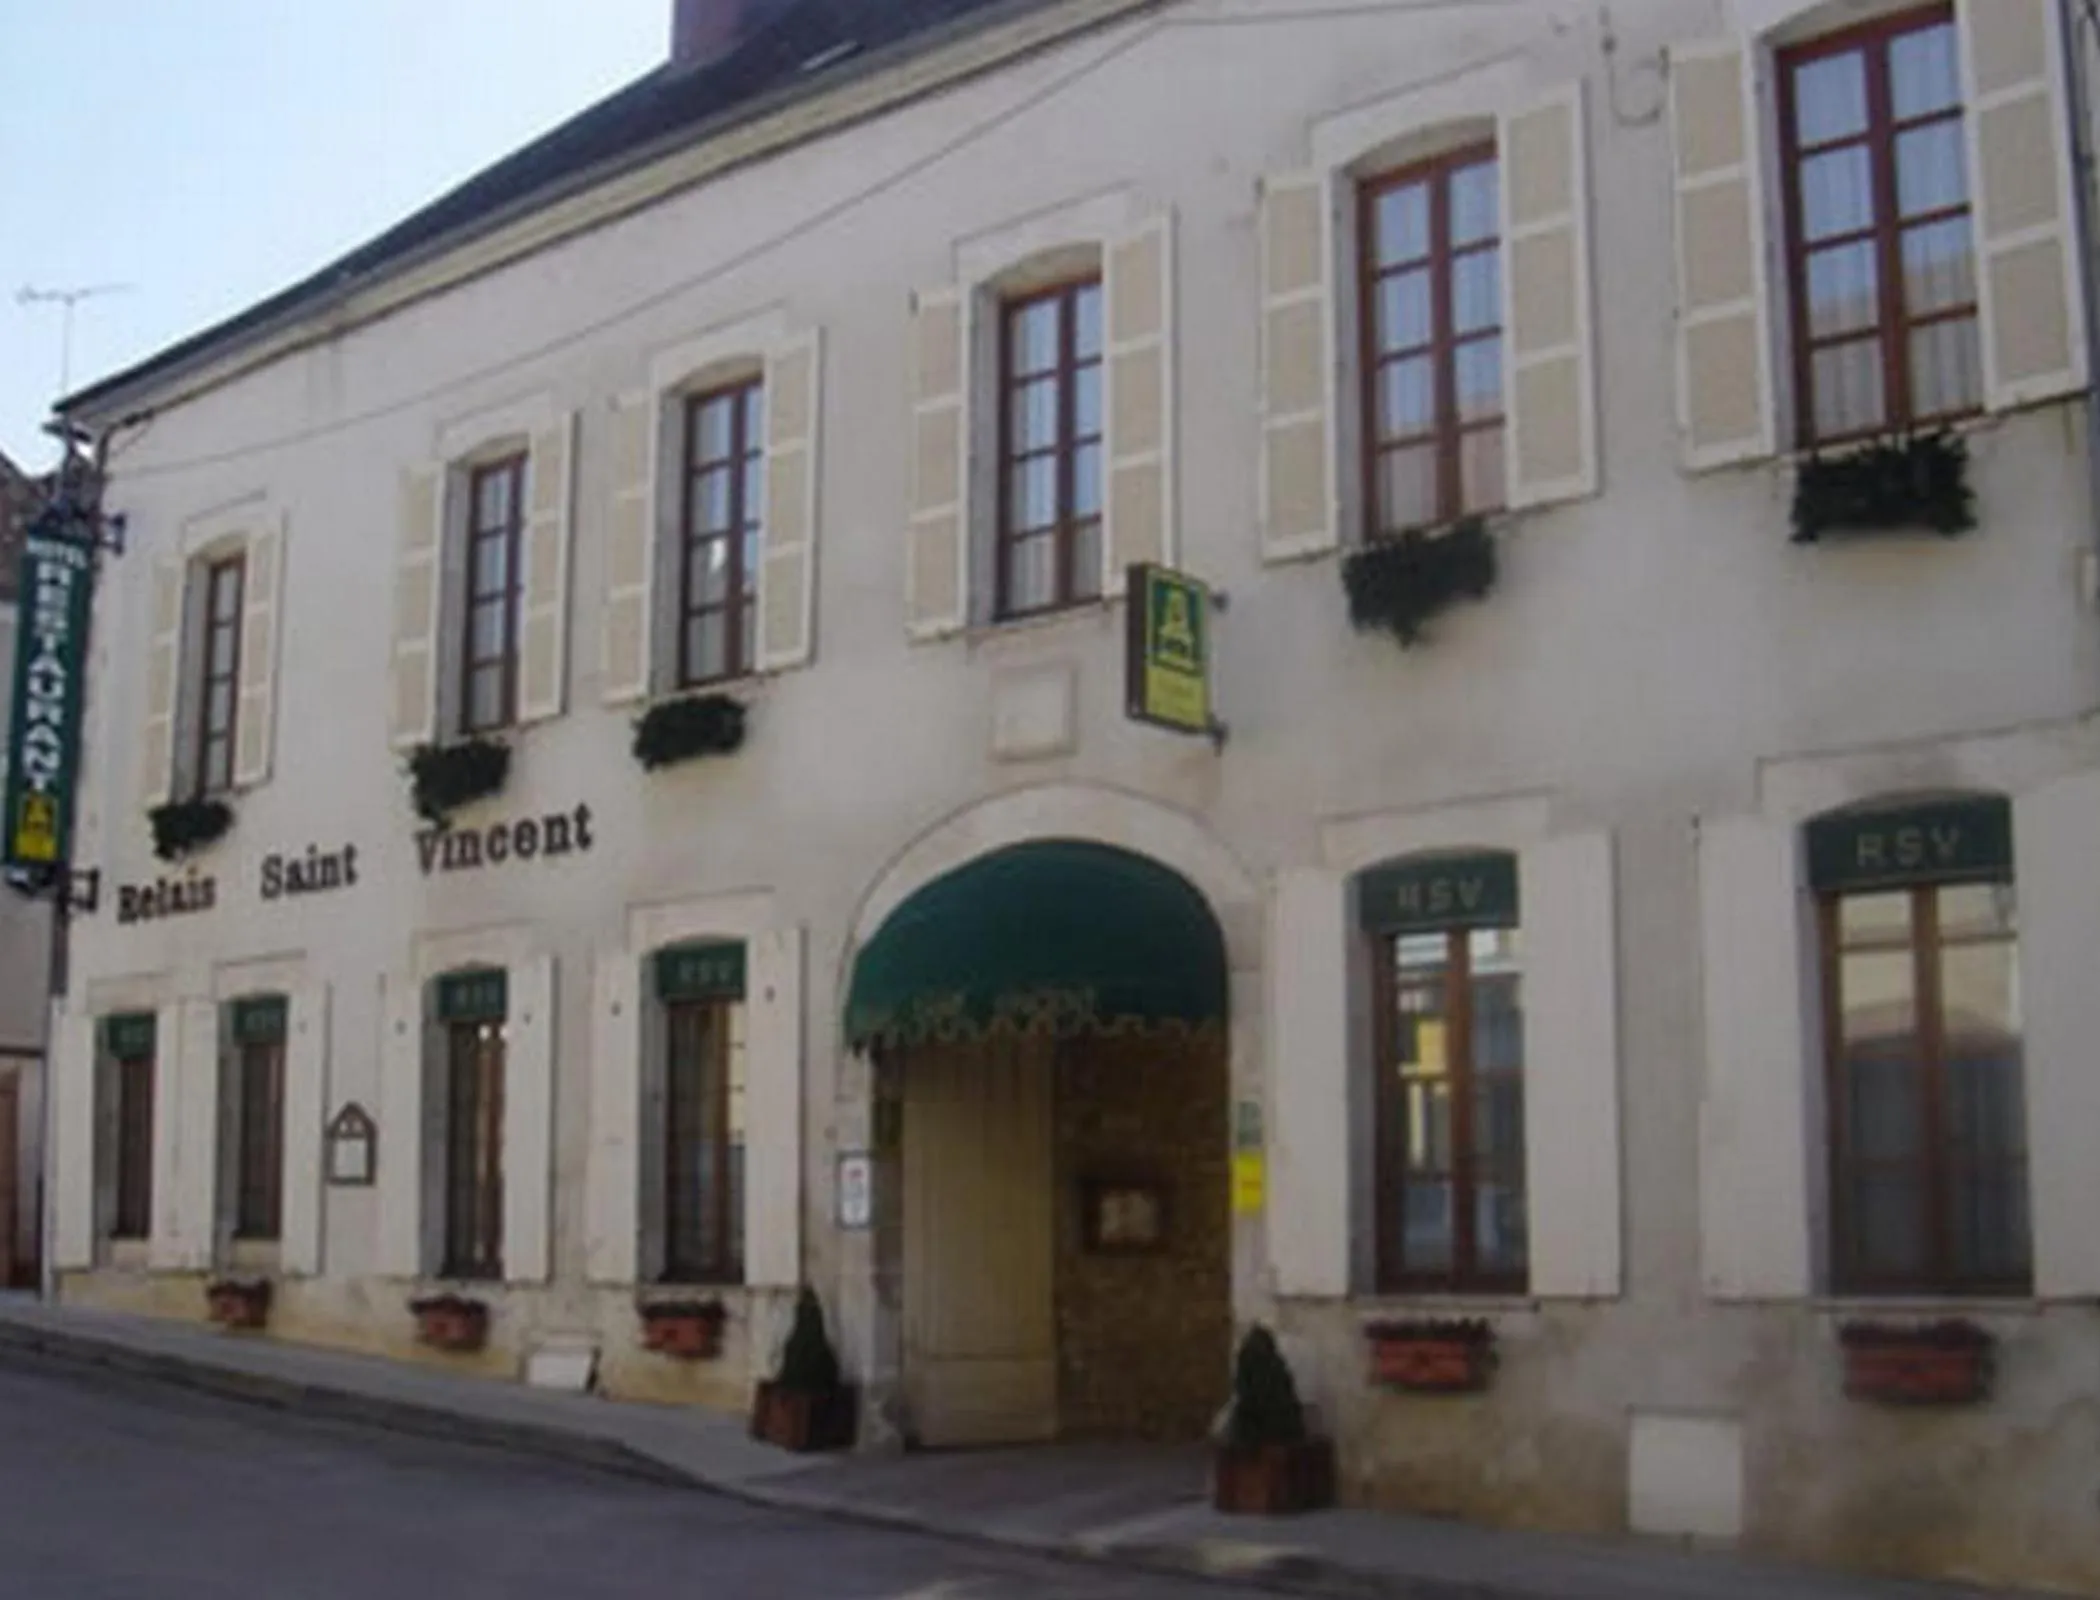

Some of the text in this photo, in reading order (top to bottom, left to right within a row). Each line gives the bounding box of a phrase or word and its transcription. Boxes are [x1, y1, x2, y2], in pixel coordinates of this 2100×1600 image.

[22, 561, 71, 791] RESTAURANT
[116, 801, 595, 925] Relais Saint Vincent
[1855, 820, 1962, 868] RSV
